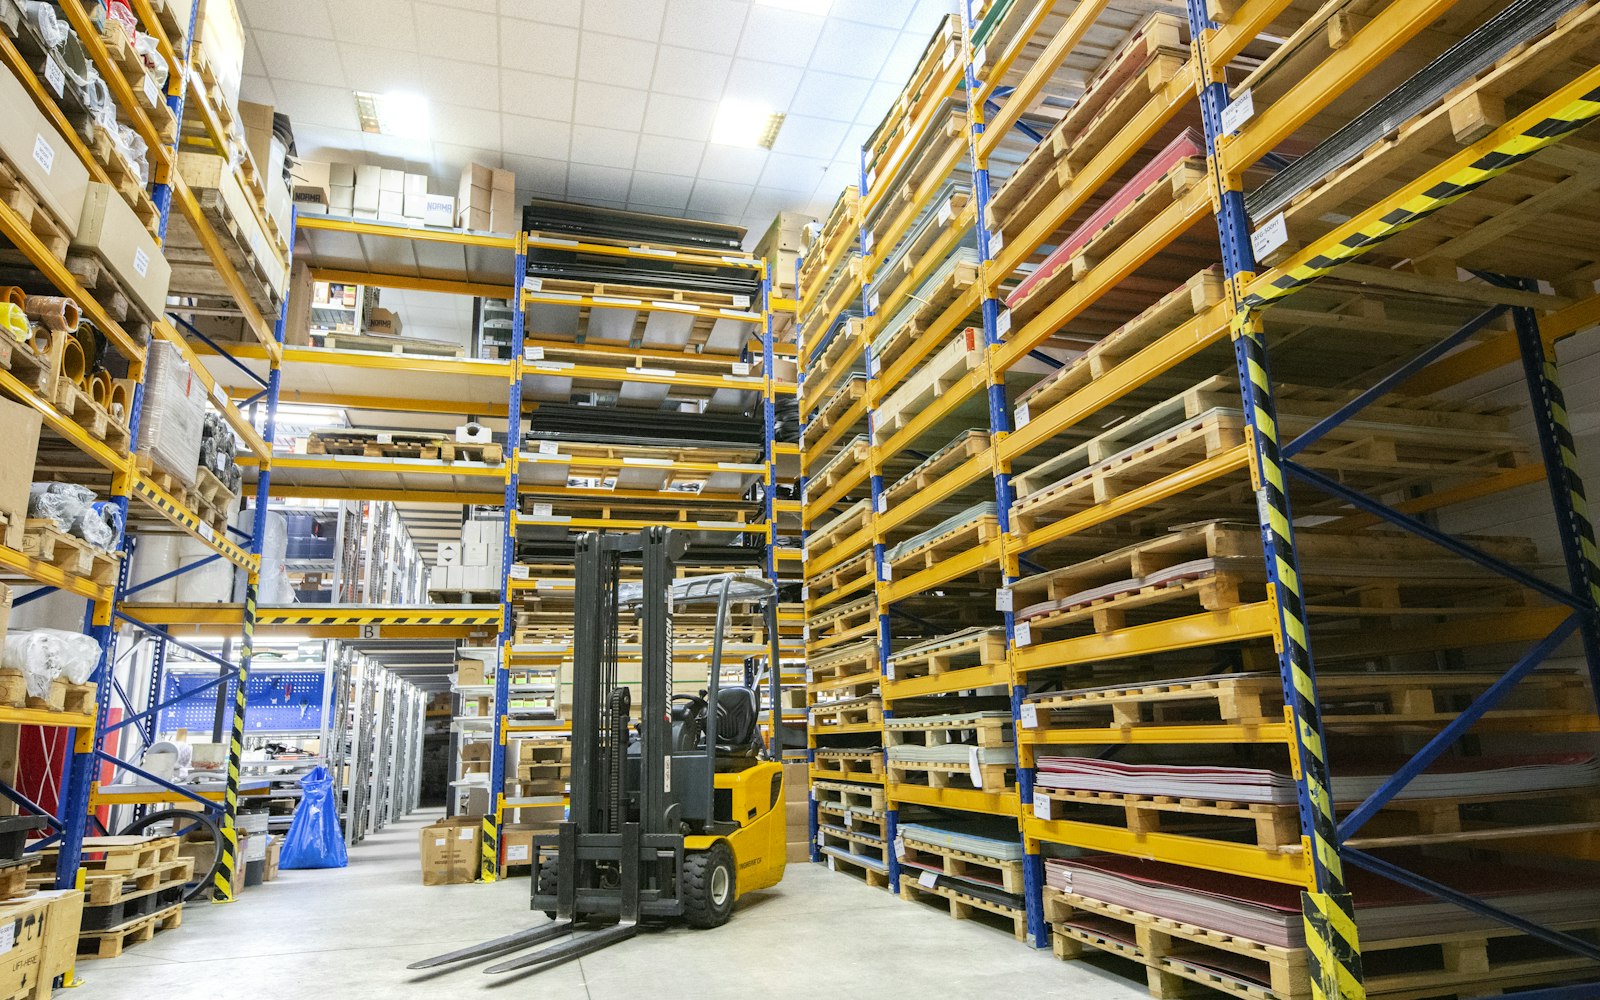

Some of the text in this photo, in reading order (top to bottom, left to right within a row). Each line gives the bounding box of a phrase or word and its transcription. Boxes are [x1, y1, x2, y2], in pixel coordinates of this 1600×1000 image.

[295, 192, 321, 203] NORMA
[427, 202, 453, 213] NORMA
[370, 319, 392, 329] NORMA
[365, 626, 373, 637] B
[664, 617, 673, 723] JUNGHEINRICH
